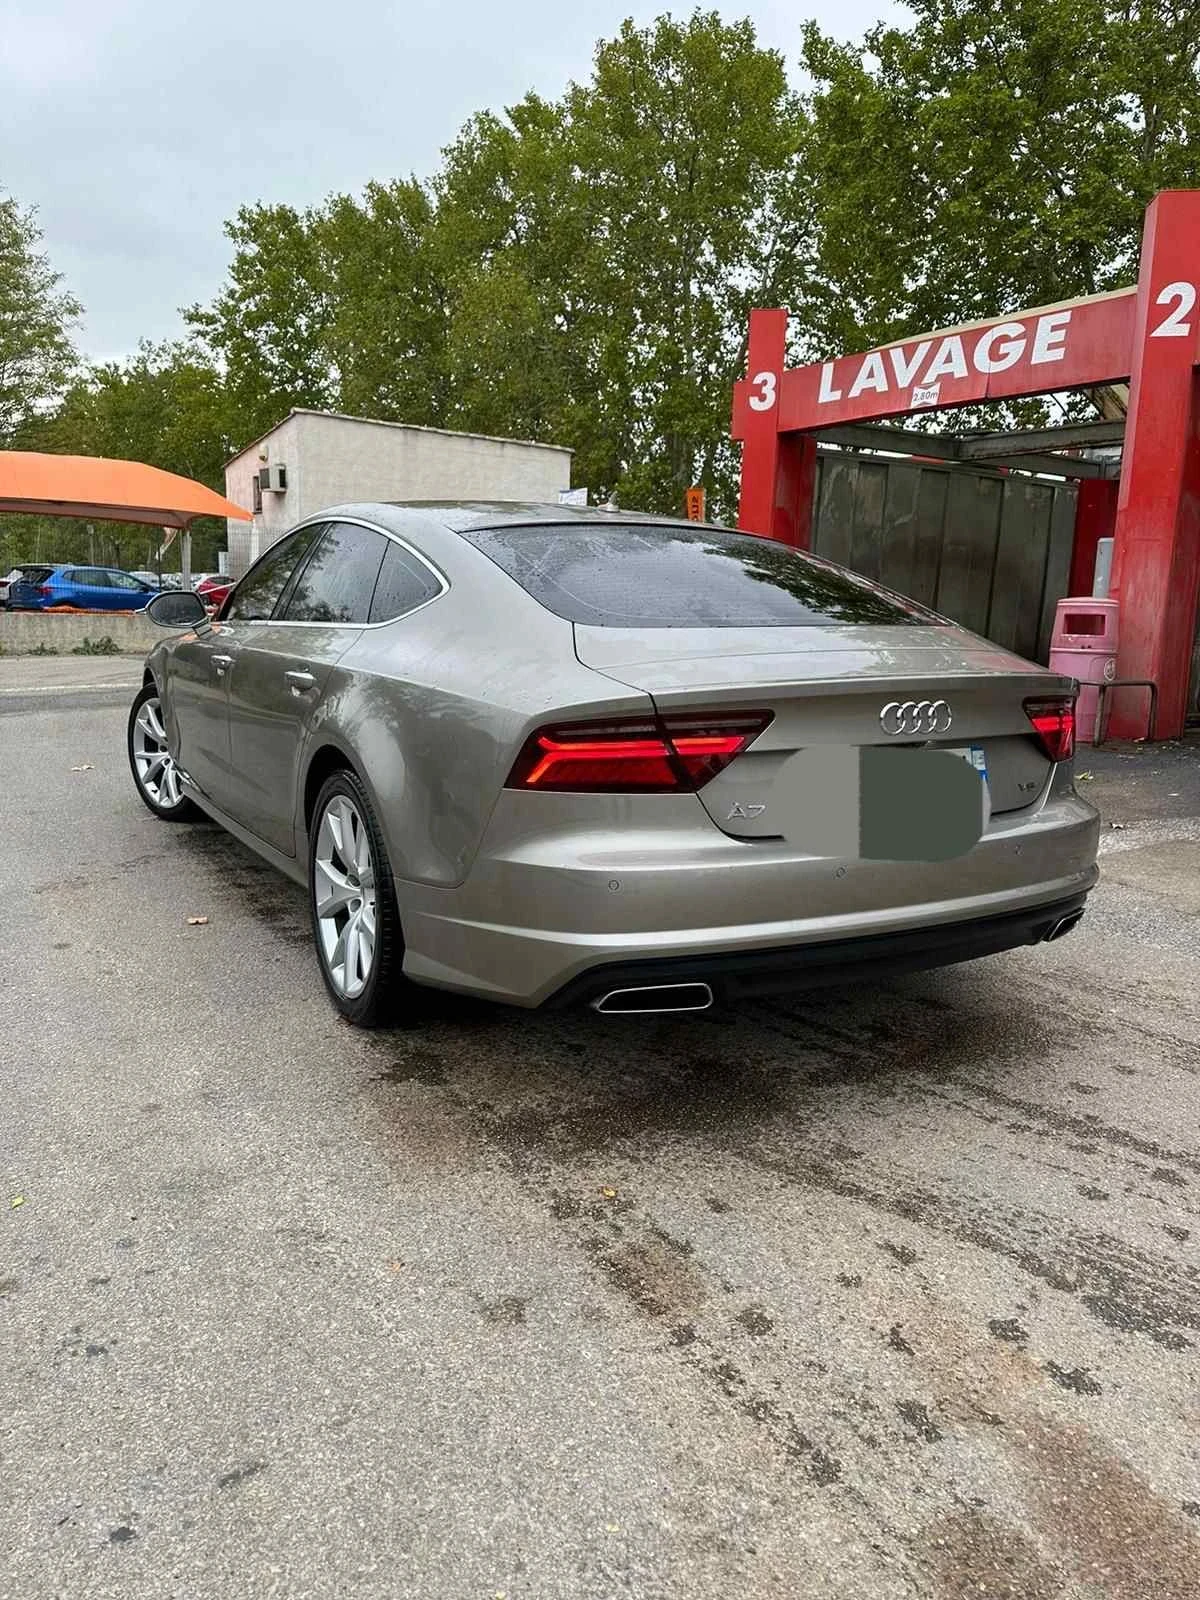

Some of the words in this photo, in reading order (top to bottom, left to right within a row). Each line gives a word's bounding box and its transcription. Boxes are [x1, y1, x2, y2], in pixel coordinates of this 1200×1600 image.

[1150, 281, 1196, 337] 2
[817, 310, 1072, 404] LAVAGE
[749, 371, 776, 411] 3
[727, 803, 766, 819] A7
